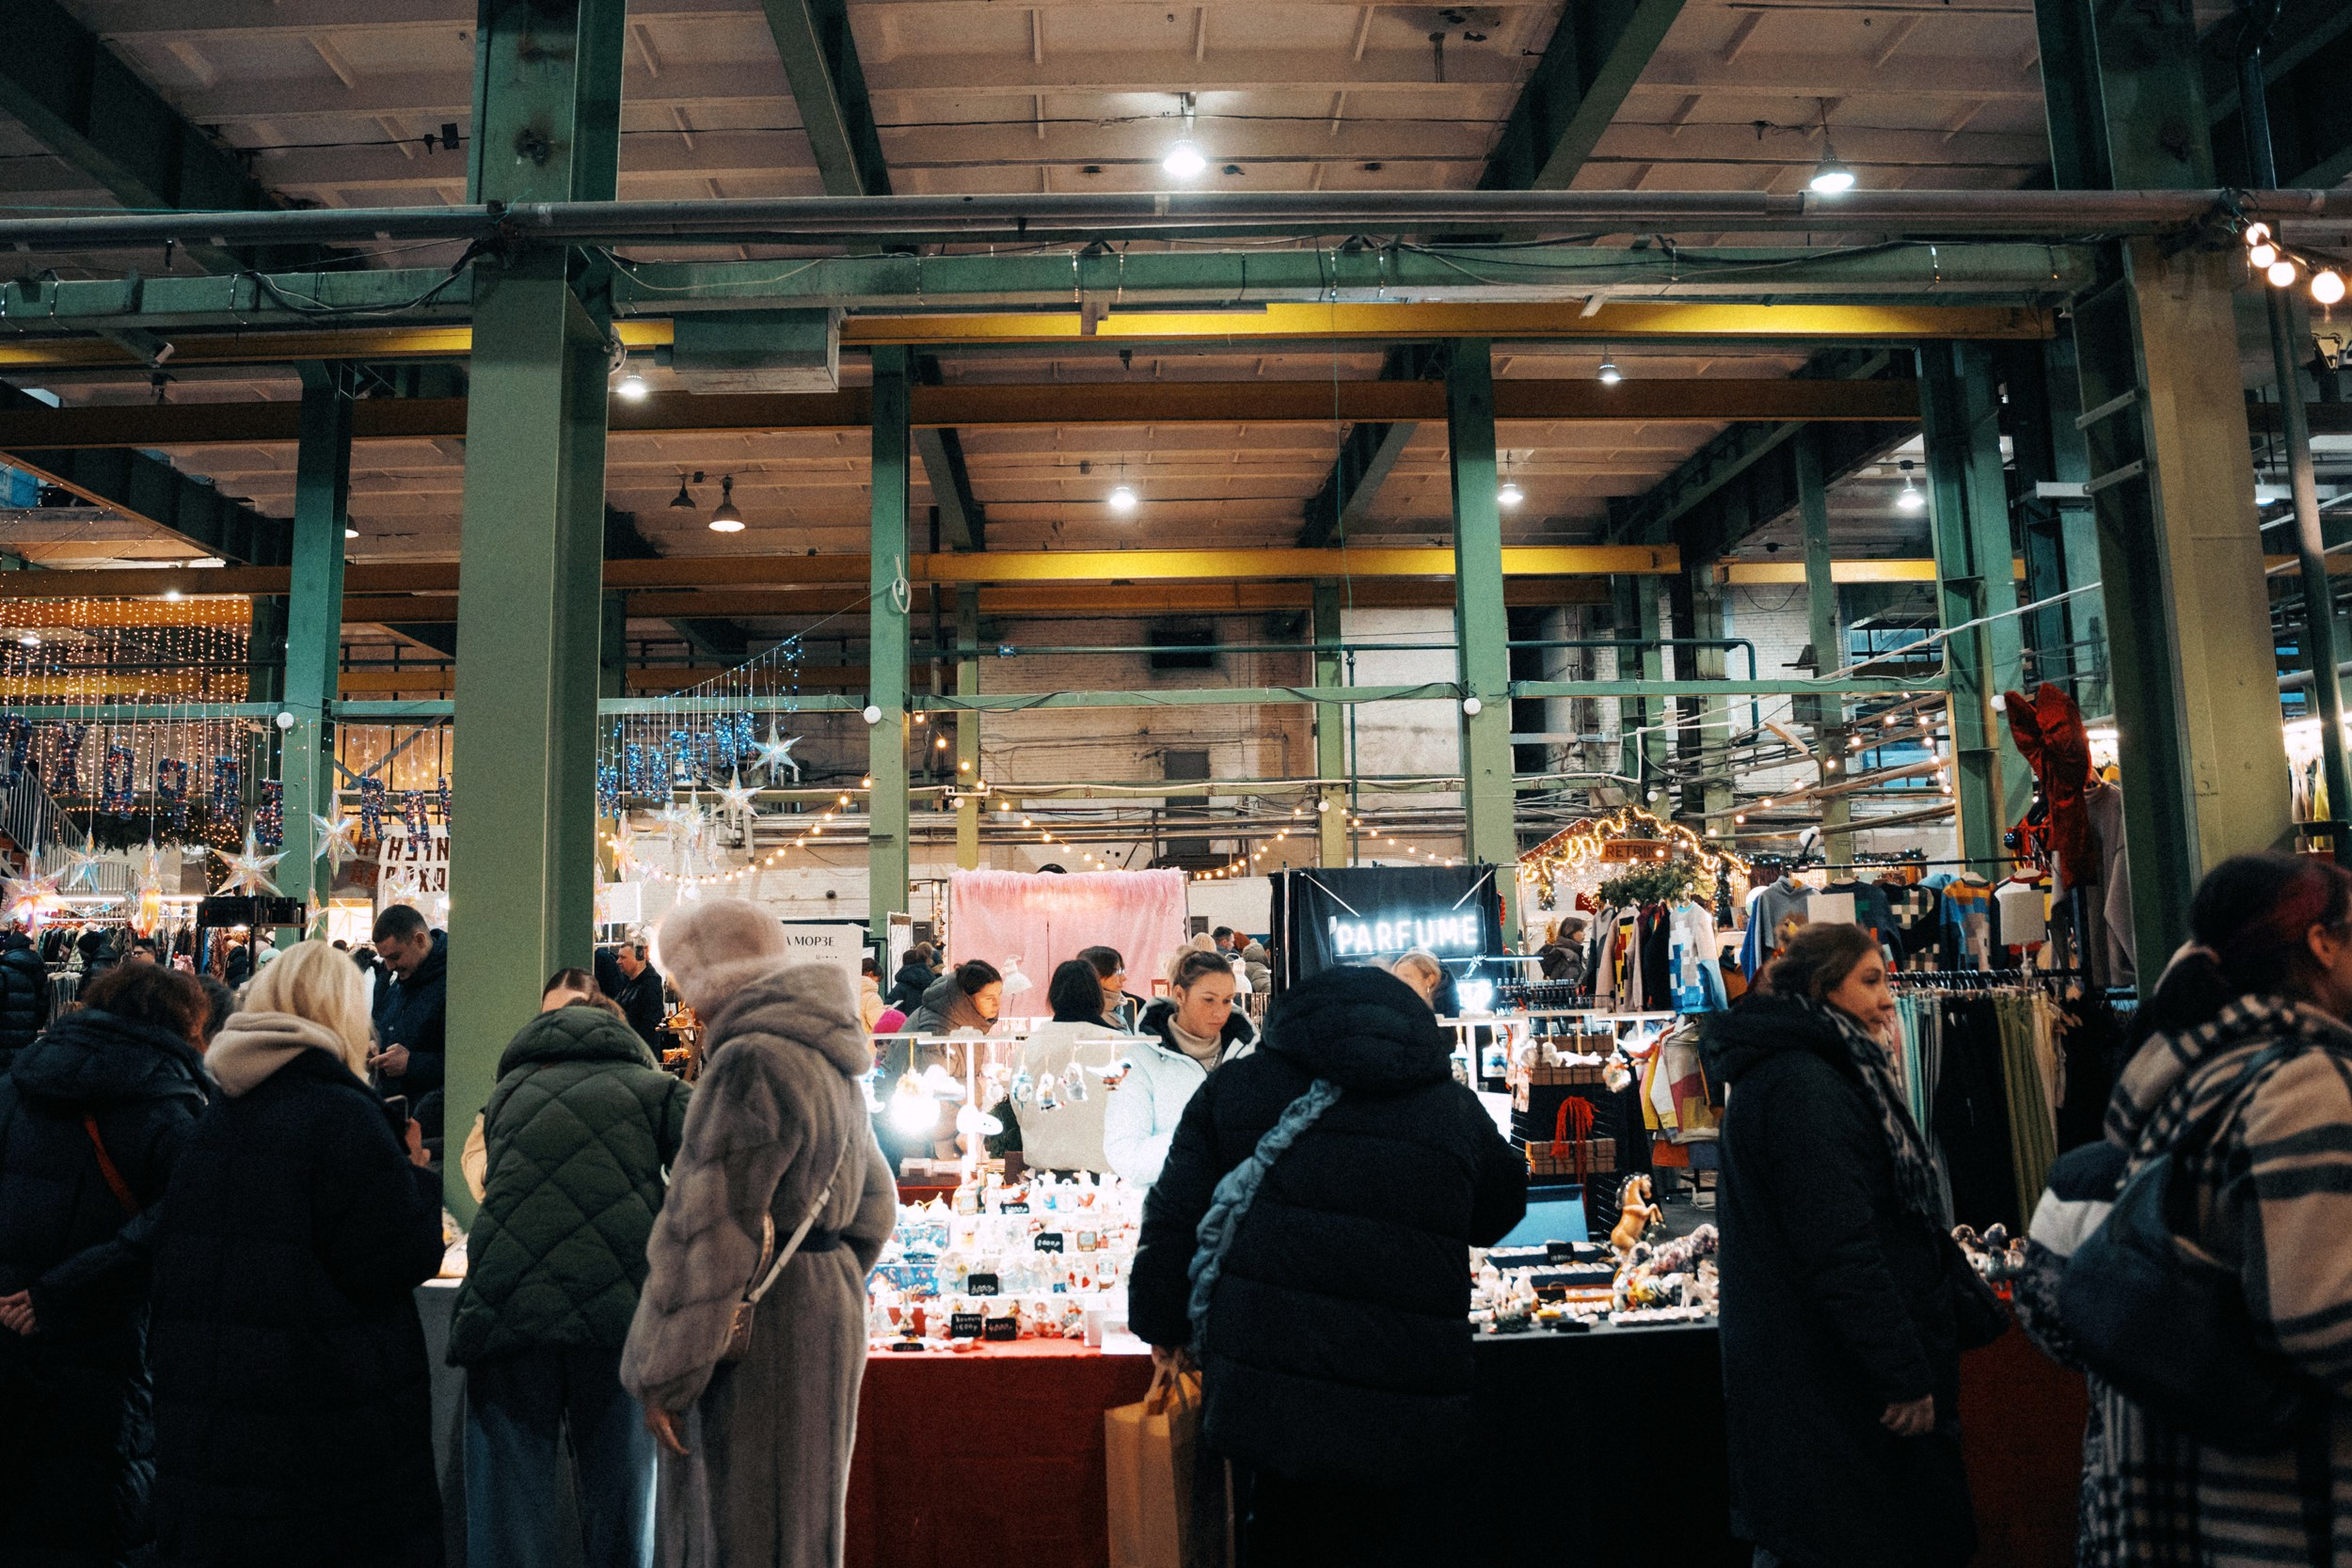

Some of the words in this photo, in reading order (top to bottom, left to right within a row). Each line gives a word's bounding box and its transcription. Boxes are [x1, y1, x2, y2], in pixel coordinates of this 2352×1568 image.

[1605, 845, 1664, 858] RETRIK
[794, 936, 835, 947] МОРЗЕ
[1336, 915, 1478, 955] PARFUME
